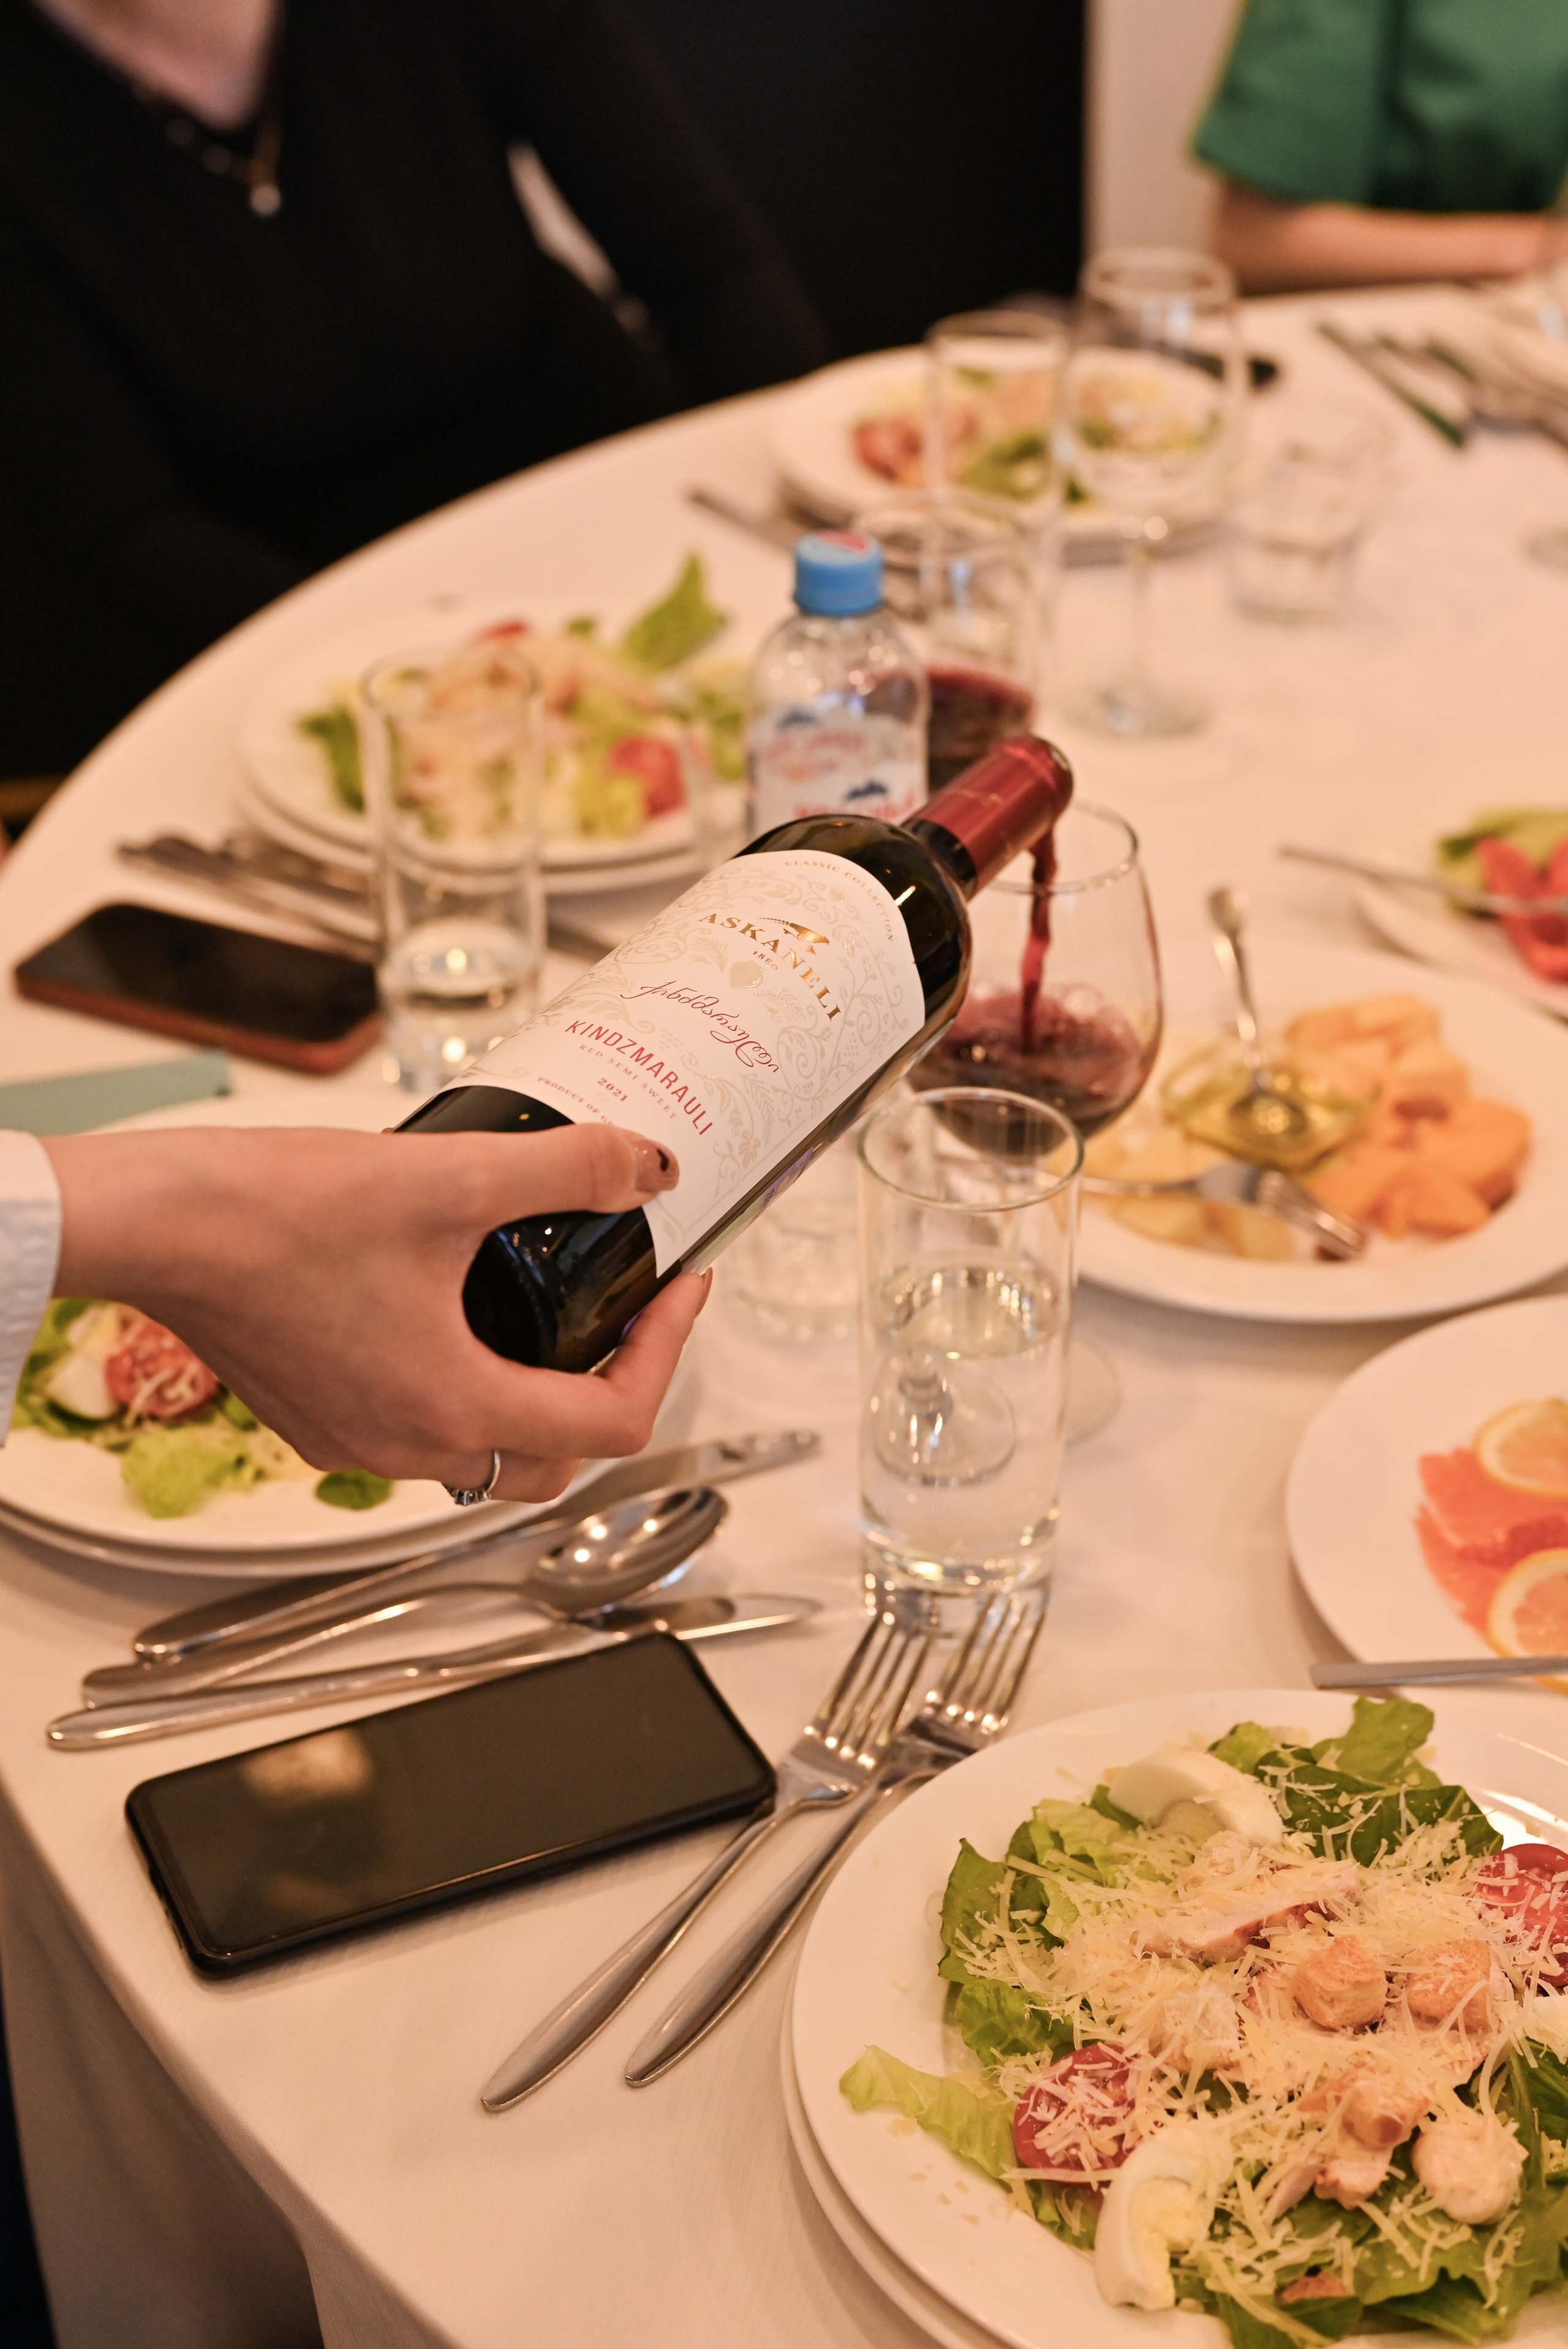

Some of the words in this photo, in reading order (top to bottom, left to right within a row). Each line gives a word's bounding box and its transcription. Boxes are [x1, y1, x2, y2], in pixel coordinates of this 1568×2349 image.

[785, 860, 840, 872] CLASSIC
[845, 871, 894, 942] COLLECTION
[698, 913, 842, 1022] ASKANELI
[752, 950, 779, 970] 1880
[537, 1076, 585, 1103] PRODUCT
[586, 1103, 600, 1114] OF
[565, 1019, 714, 1135] KINDZMARAULI
[579, 1043, 603, 1058] RED
[608, 1057, 638, 1080] SEMI
[641, 1082, 677, 1119] SWEET
[597, 1077, 628, 1102] 2021
